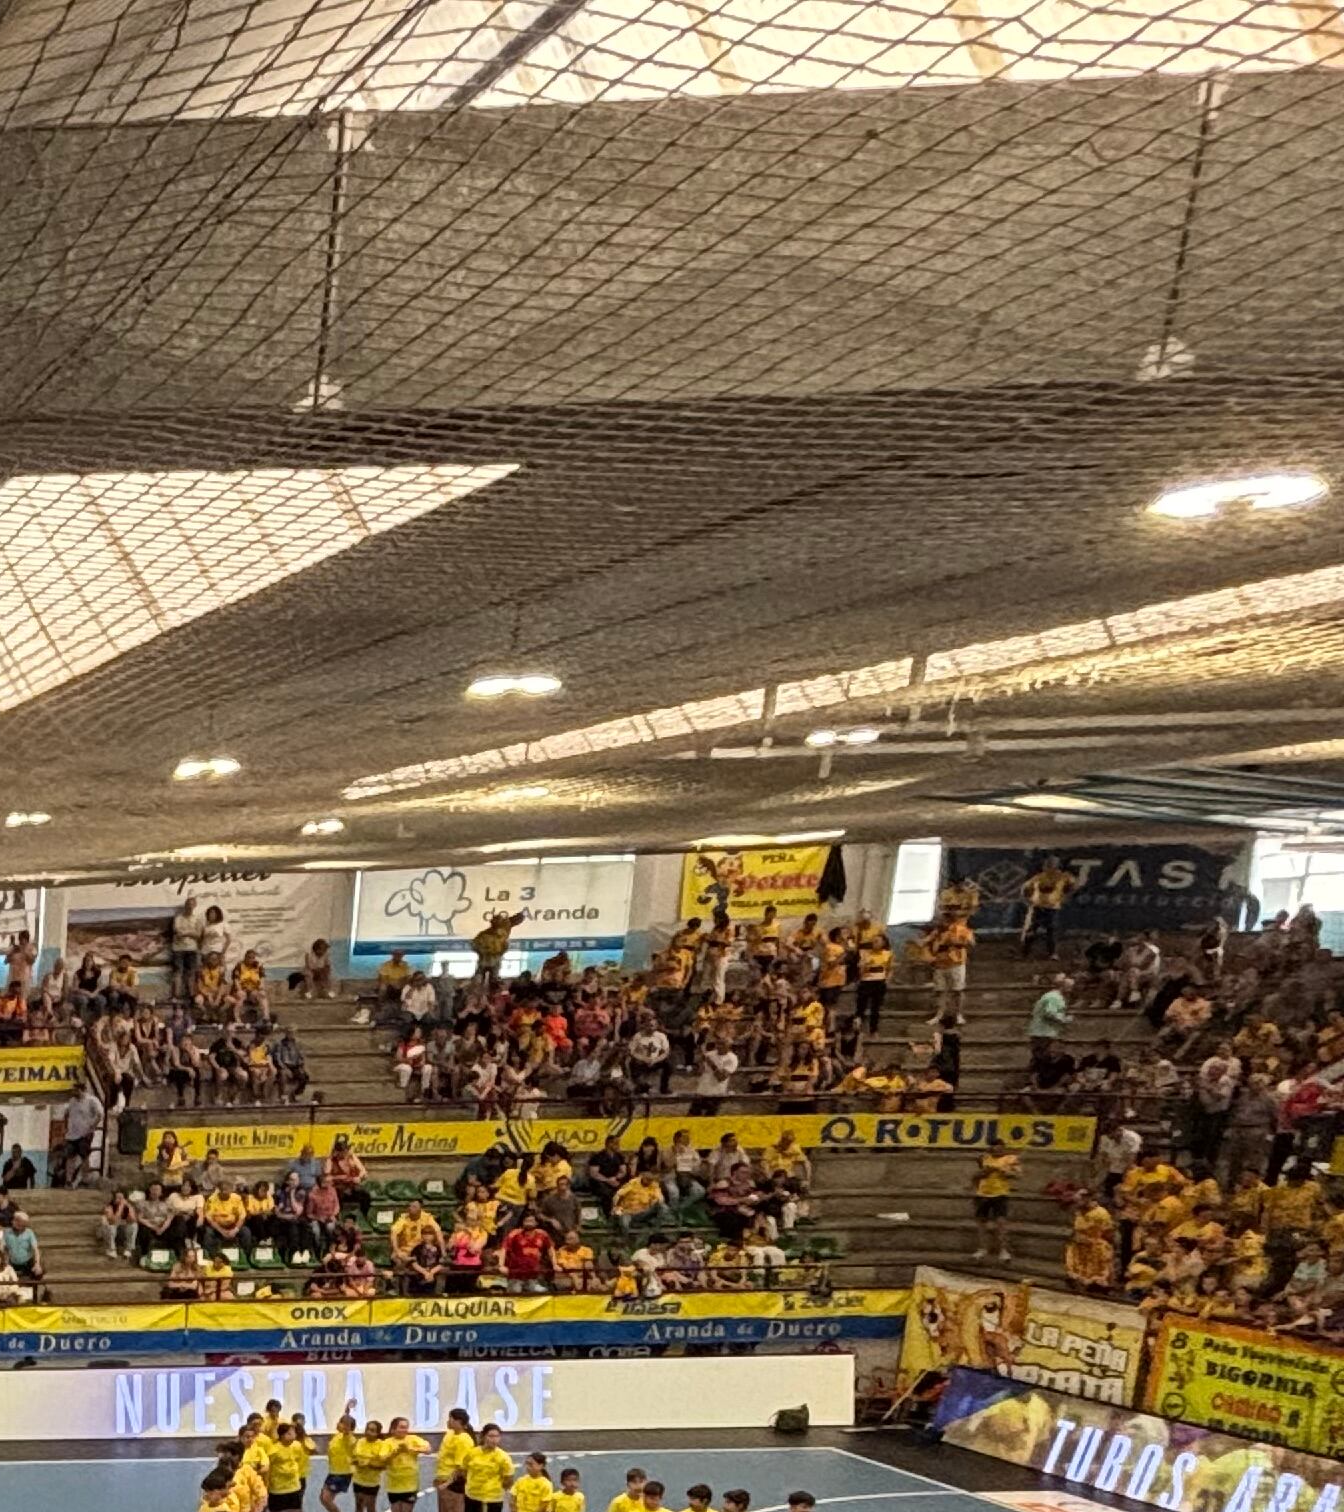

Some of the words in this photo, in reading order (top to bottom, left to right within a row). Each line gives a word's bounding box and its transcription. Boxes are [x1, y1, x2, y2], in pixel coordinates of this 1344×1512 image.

[484, 886, 511, 902] La
[518, 886, 536, 902] 3
[518, 904, 600, 923] Aranda
[205, 1129, 249, 1148] Little
[390, 1124, 459, 1153] Marina
[290, 1304, 347, 1321] onex
[279, 1328, 362, 1349] Aranda
[404, 1326, 479, 1346] Duero
[644, 1320, 726, 1341] Aranda
[766, 1319, 843, 1340] Duero
[38, 1333, 113, 1353] Duero
[1025, 1320, 1064, 1350] LA
[1060, 1328, 1131, 1374] PEÑA
[114, 1367, 367, 1435] NUESTRA
[416, 1365, 553, 1430] BASE
[1042, 1419, 1200, 1512] TUBOS
